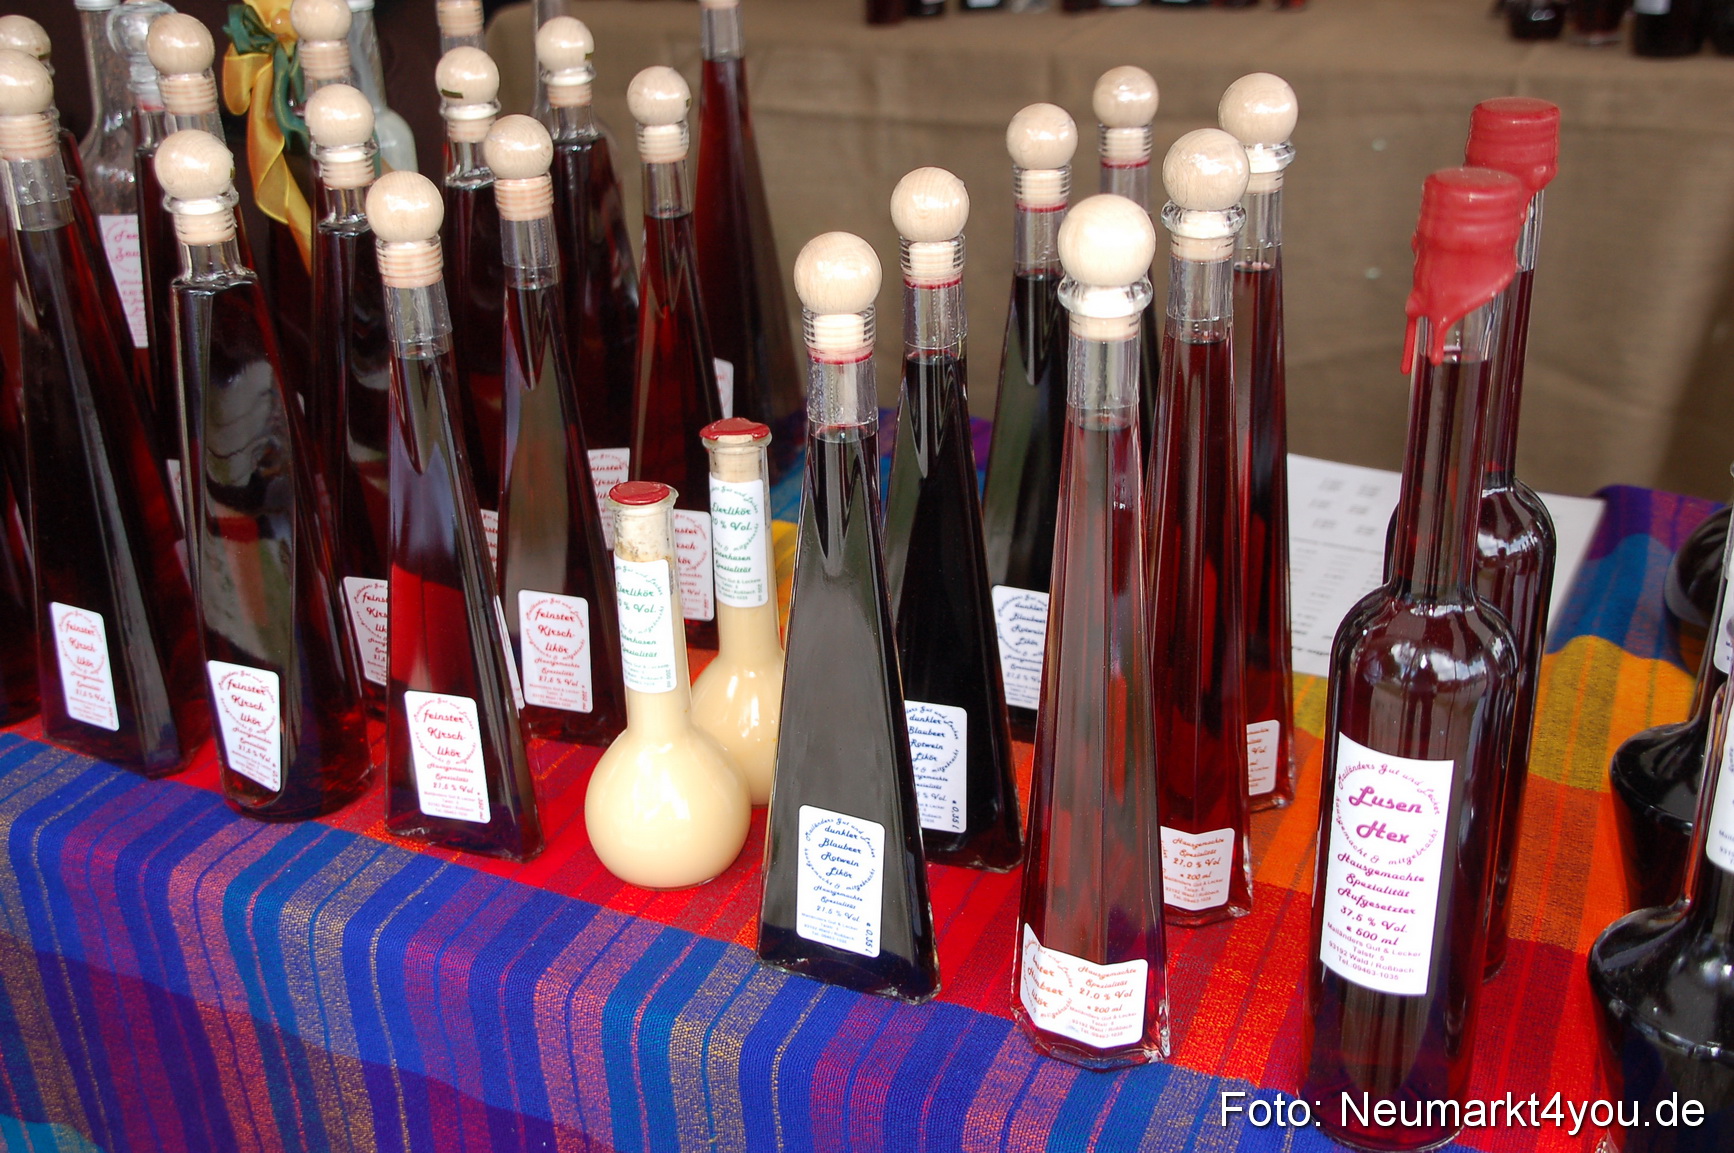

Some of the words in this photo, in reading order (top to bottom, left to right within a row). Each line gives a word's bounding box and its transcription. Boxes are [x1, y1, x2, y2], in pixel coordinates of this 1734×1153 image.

[535, 608, 575, 623] feinster
[545, 642, 569, 654] likör
[227, 678, 267, 696] feinster
[240, 712, 263, 728] likör
[423, 708, 465, 724] feinster
[909, 714, 942, 725] dunkler
[908, 725, 946, 739] Blaubeer
[436, 745, 461, 758] likör
[909, 738, 945, 751] Rotwein
[911, 752, 938, 763] Likör
[1378, 763, 1401, 775] Gut
[1402, 773, 1425, 786] und
[1416, 787, 1441, 816] Lecker
[1348, 785, 1423, 814] Lusen
[824, 825, 859, 840] dunkler
[1355, 820, 1410, 844] Hex
[818, 837, 862, 855] Blaubeer
[820, 851, 860, 868] Rotwein
[1337, 852, 1426, 883] Hausgemachte
[825, 866, 853, 879] Likör
[1345, 872, 1411, 898] Spezialität
[1337, 887, 1417, 915] Aufgesetzter
[1367, 917, 1377, 928] %
[1381, 919, 1408, 934] Vol.
[1327, 921, 1364, 948] Mailänders
[1365, 942, 1381, 953] Gut
[1383, 947, 1390, 955] &
[1391, 948, 1422, 958] Lecker
[1355, 927, 1379, 942] 500
[1380, 937, 1400, 947] ml
[1349, 952, 1369, 966] Wald
[1114, 988, 1134, 999] Vol
[1094, 1004, 1111, 1014] 200
[1111, 1003, 1123, 1013] ml
